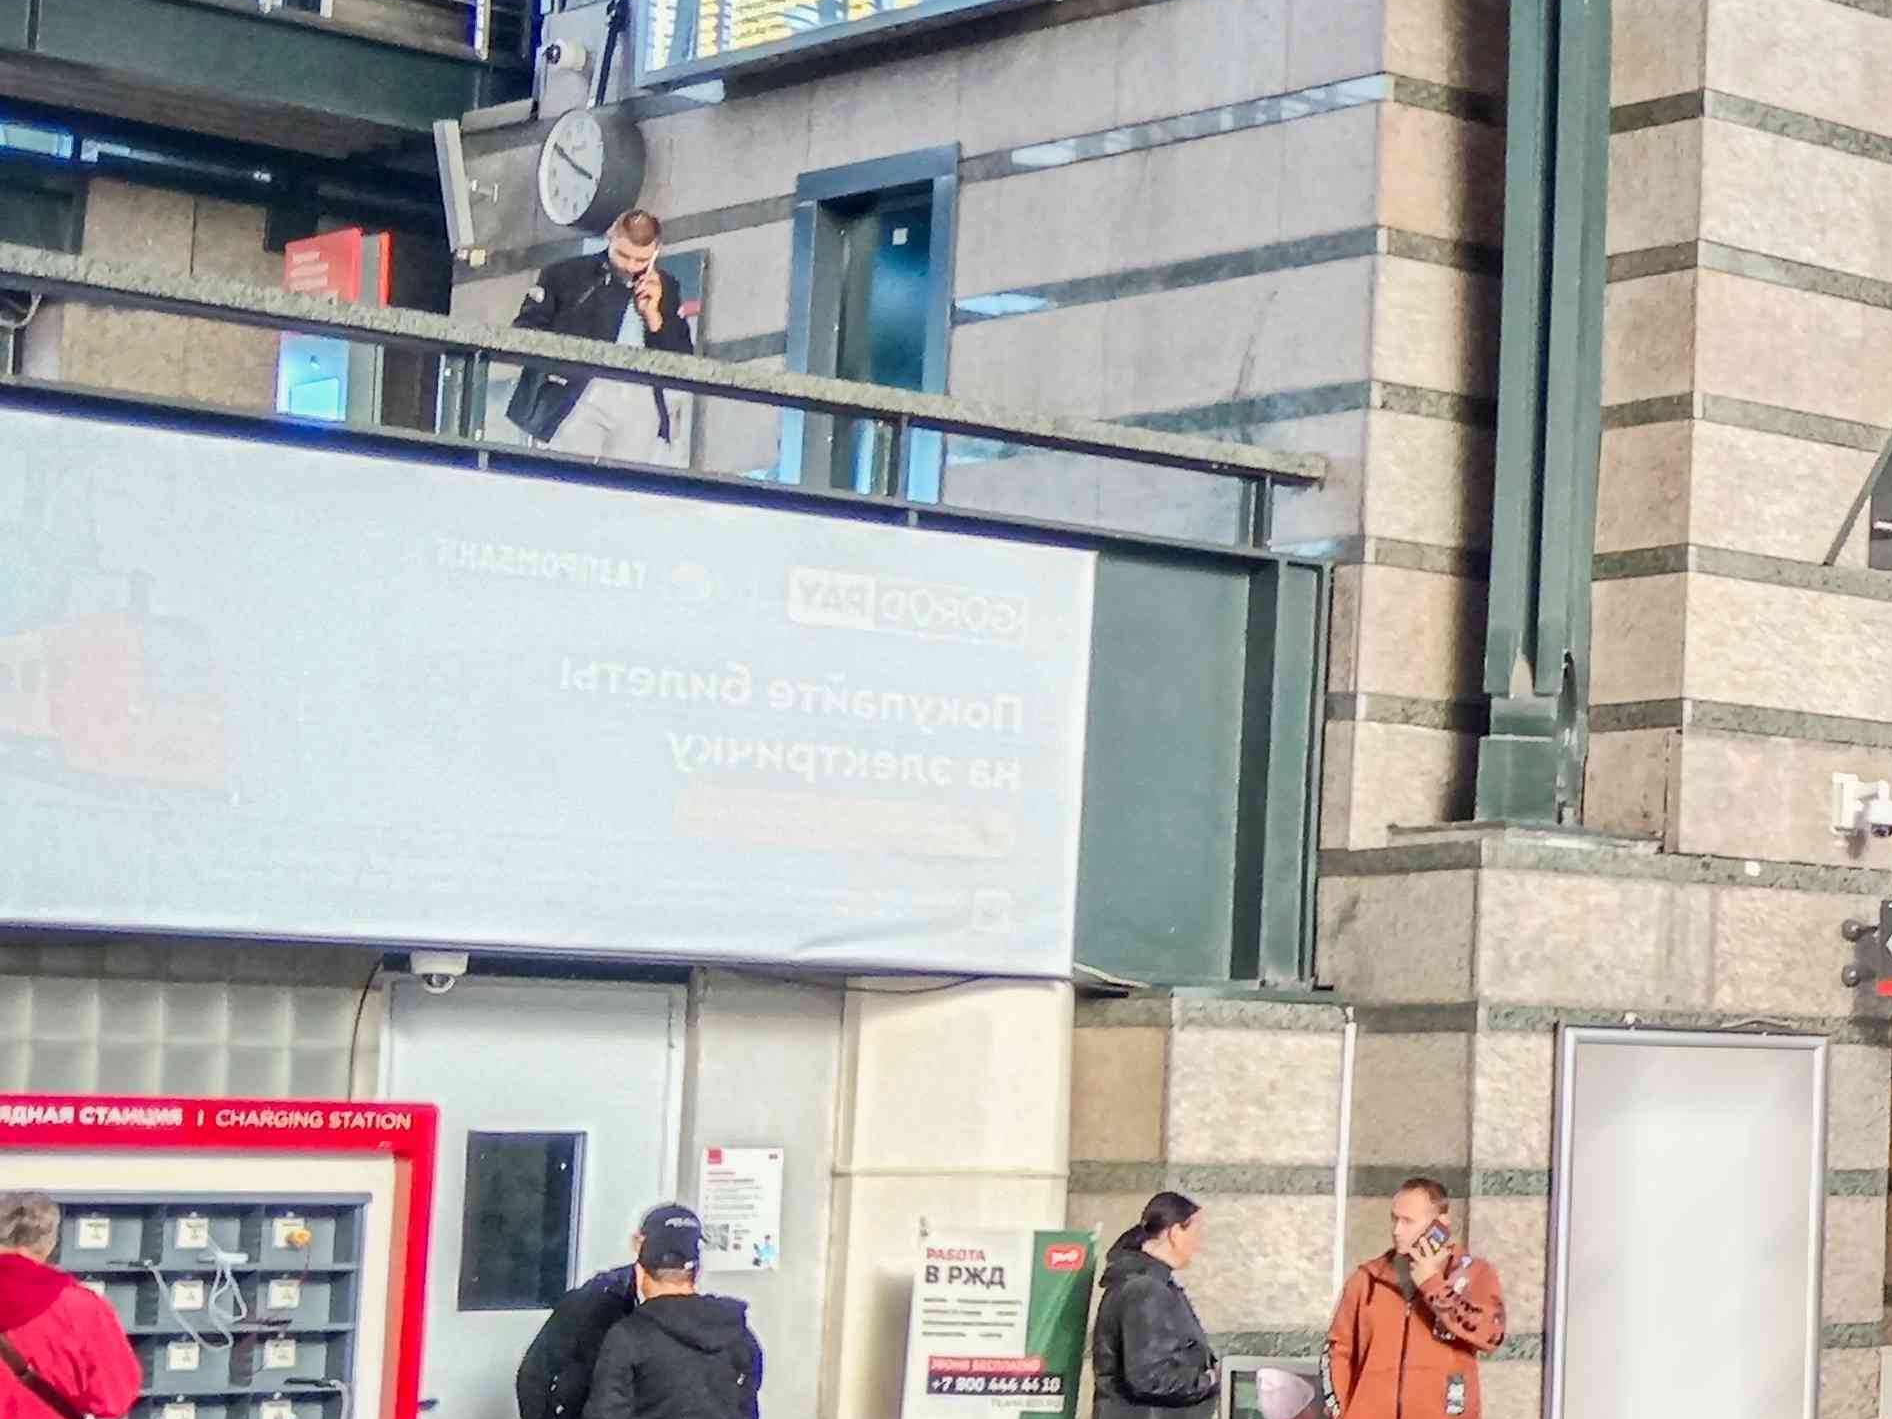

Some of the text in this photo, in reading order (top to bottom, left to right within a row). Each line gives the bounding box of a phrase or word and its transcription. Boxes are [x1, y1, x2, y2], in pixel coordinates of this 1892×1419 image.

[79, 1105, 183, 1128] СТАНЦИЯ
[215, 1108, 412, 1131] CHARGING STATION
[926, 1247, 986, 1263] РАБОТА
[925, 1265, 1006, 1290] В РЖД
[931, 1376, 953, 1393] +7
